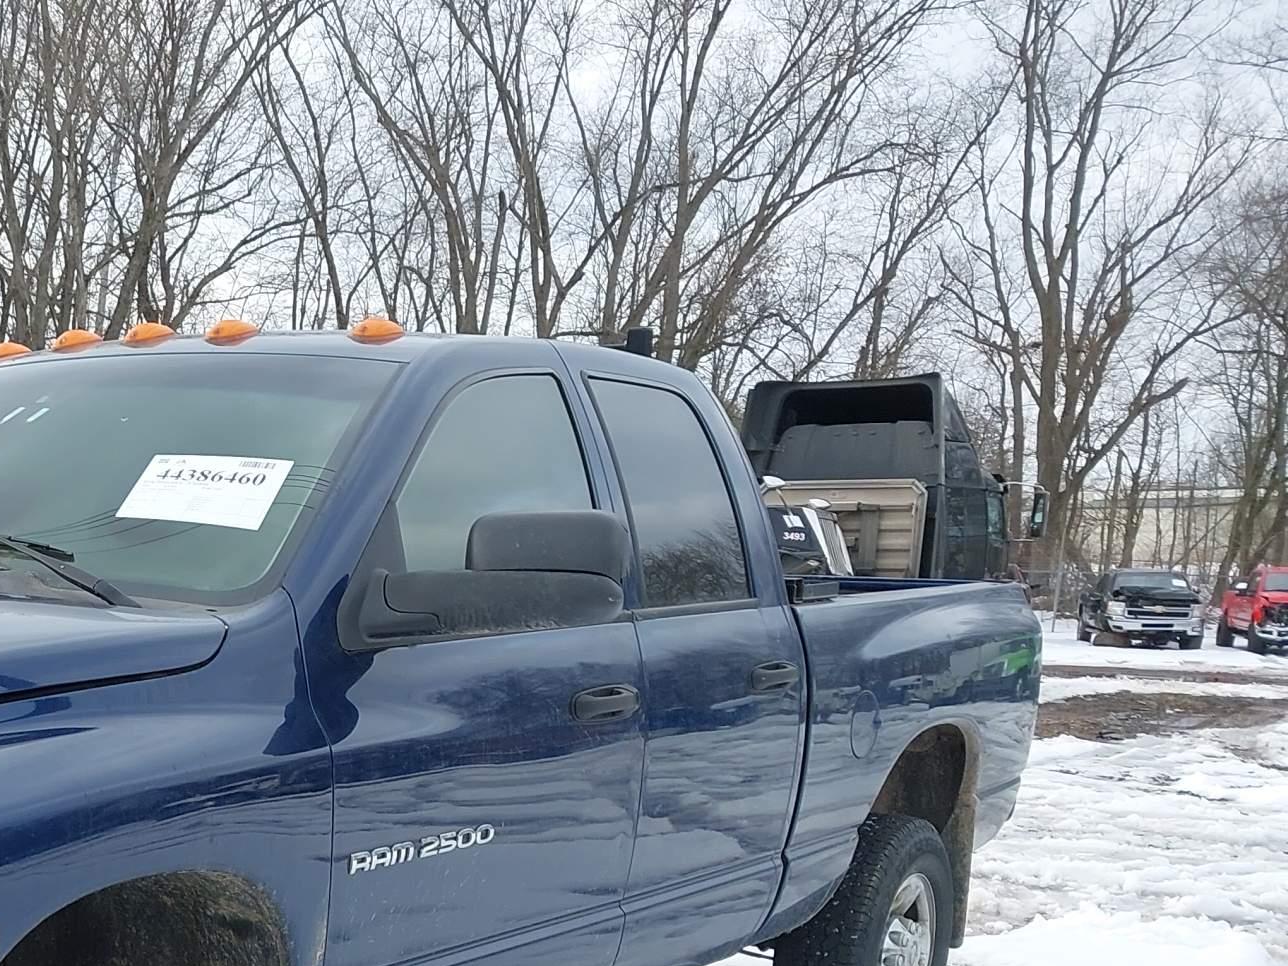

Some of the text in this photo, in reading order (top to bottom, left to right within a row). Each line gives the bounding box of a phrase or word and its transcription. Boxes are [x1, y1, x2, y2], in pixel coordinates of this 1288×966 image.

[156, 468, 267, 487] 44386460
[782, 531, 806, 541] 3493
[349, 823, 496, 875] RAM 2500
